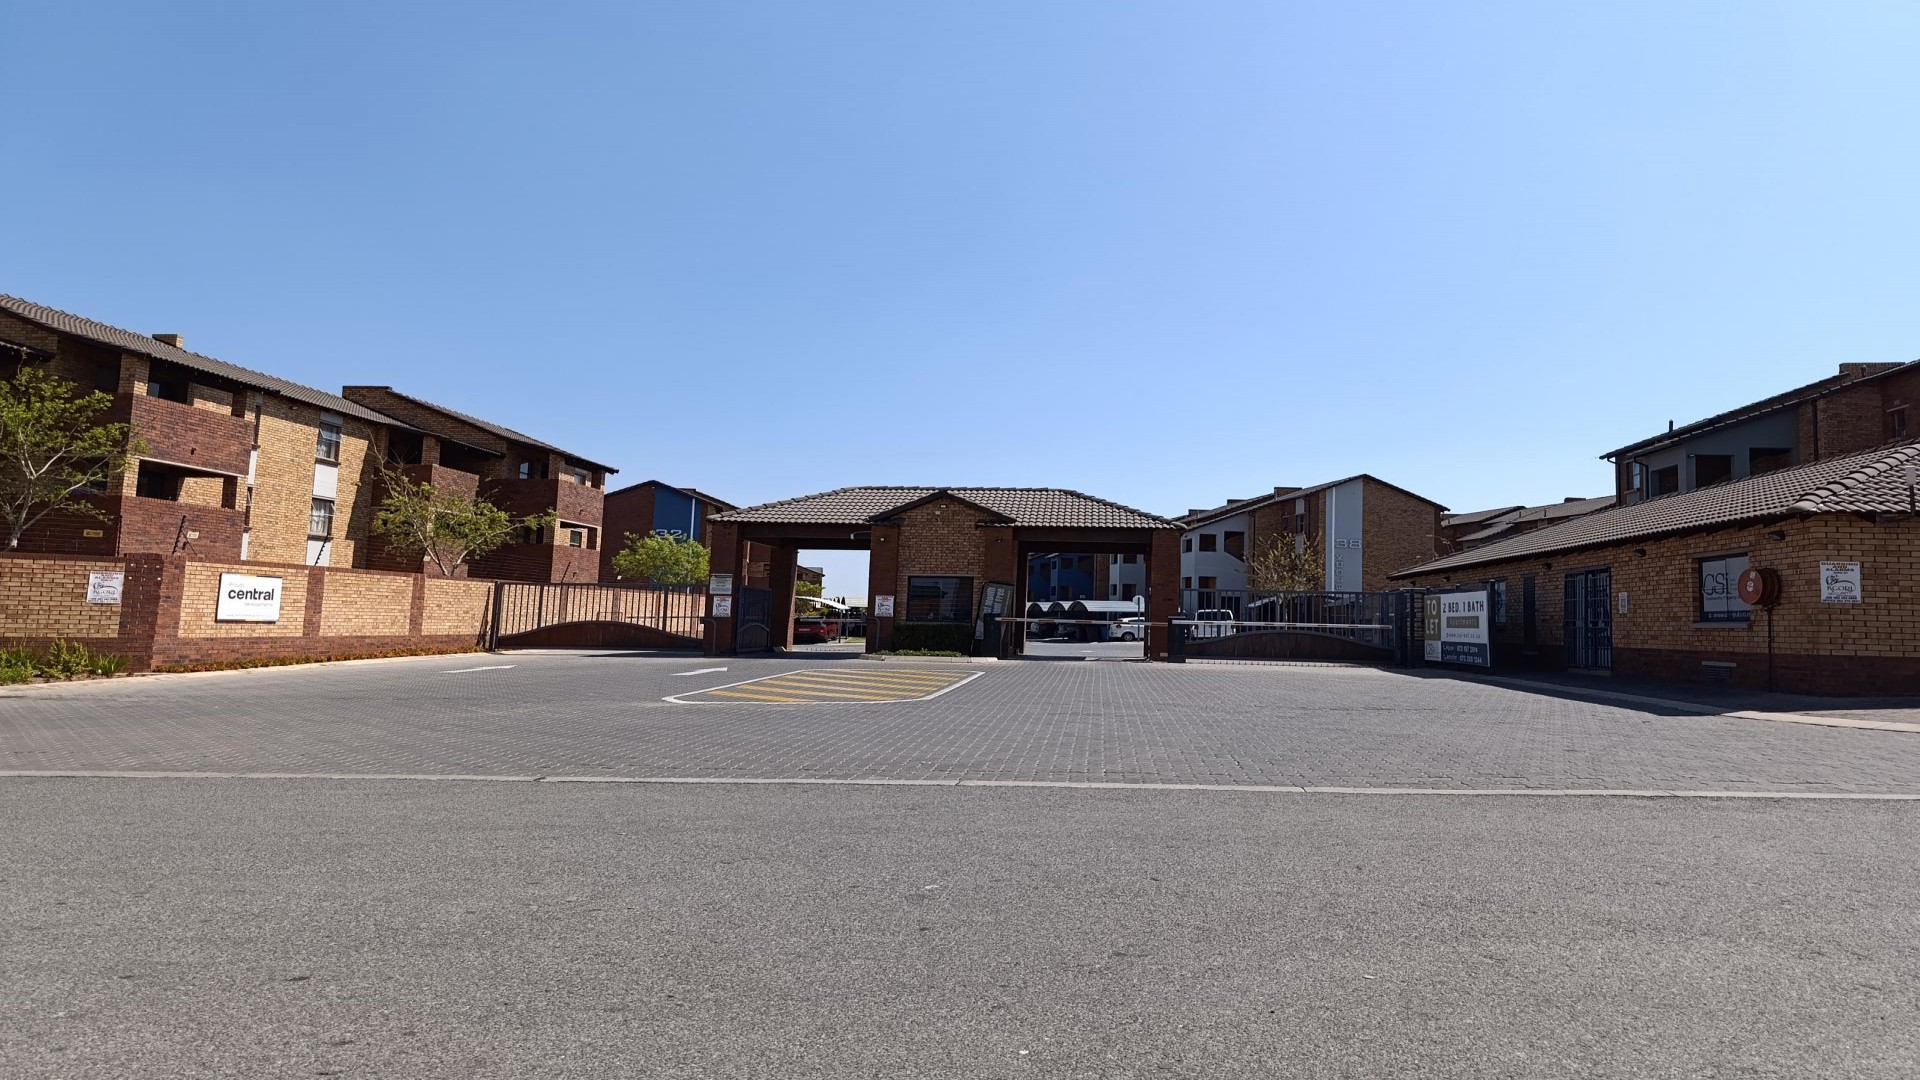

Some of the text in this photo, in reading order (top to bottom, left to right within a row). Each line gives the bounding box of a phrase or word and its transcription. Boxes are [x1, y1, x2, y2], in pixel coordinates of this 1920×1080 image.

[655, 529, 682, 538] 32
[1336, 539, 1362, 548] 38
[228, 588, 274, 601] central
[1427, 600, 1437, 615] TO
[1443, 603, 1446, 613] 2
[1468, 600, 1484, 612] BATH
[1426, 619, 1438, 635] LET
